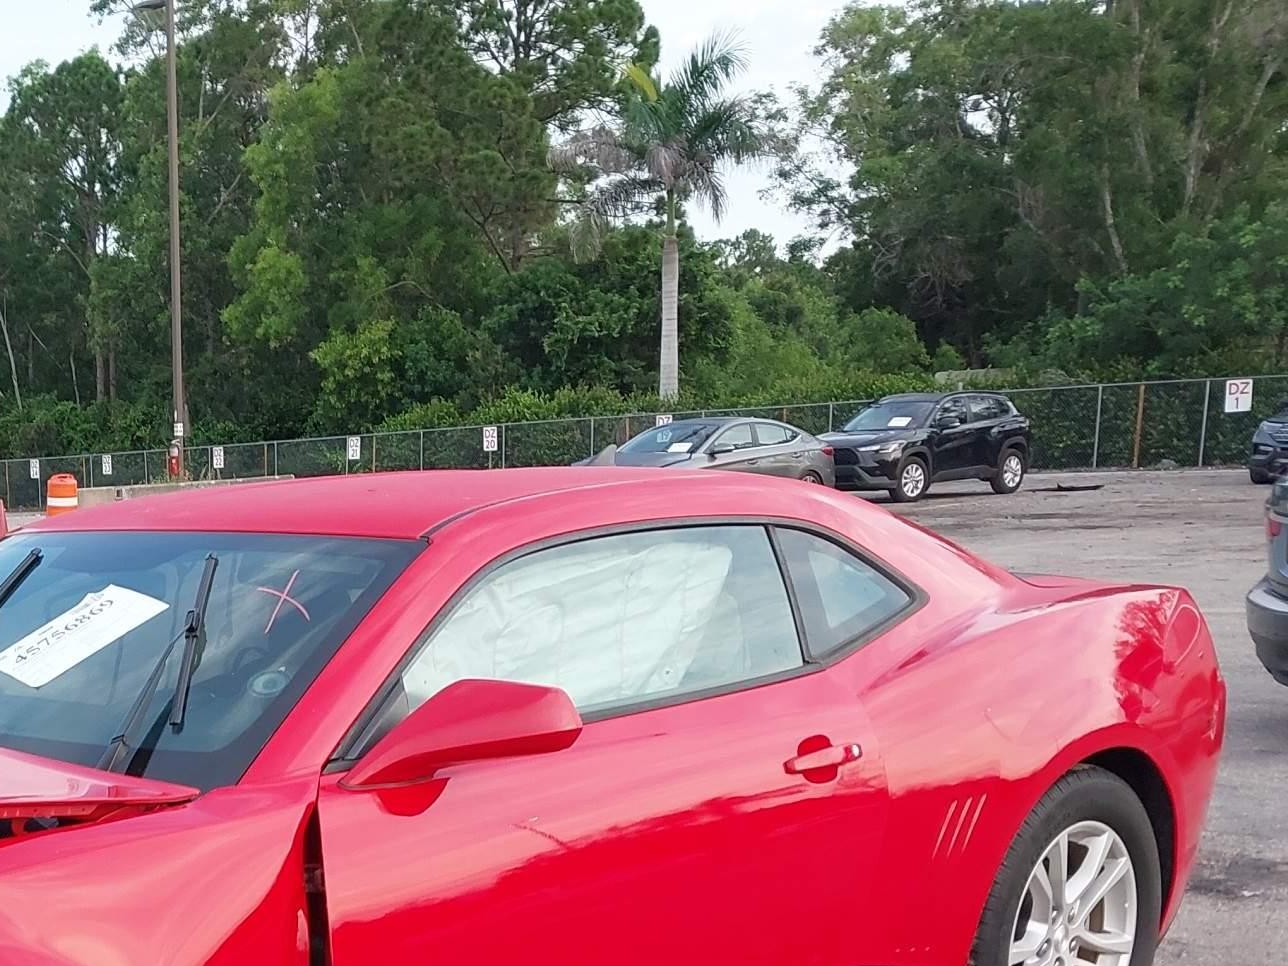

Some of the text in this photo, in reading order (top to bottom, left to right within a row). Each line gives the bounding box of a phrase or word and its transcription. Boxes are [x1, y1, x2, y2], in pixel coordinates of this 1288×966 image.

[1229, 382, 1250, 396] DZ
[484, 429, 496, 439] DZ
[349, 439, 359, 448] DZ
[486, 440, 496, 449] 20
[214, 448, 222, 457] DZ
[16, 599, 114, 663] 45756869
